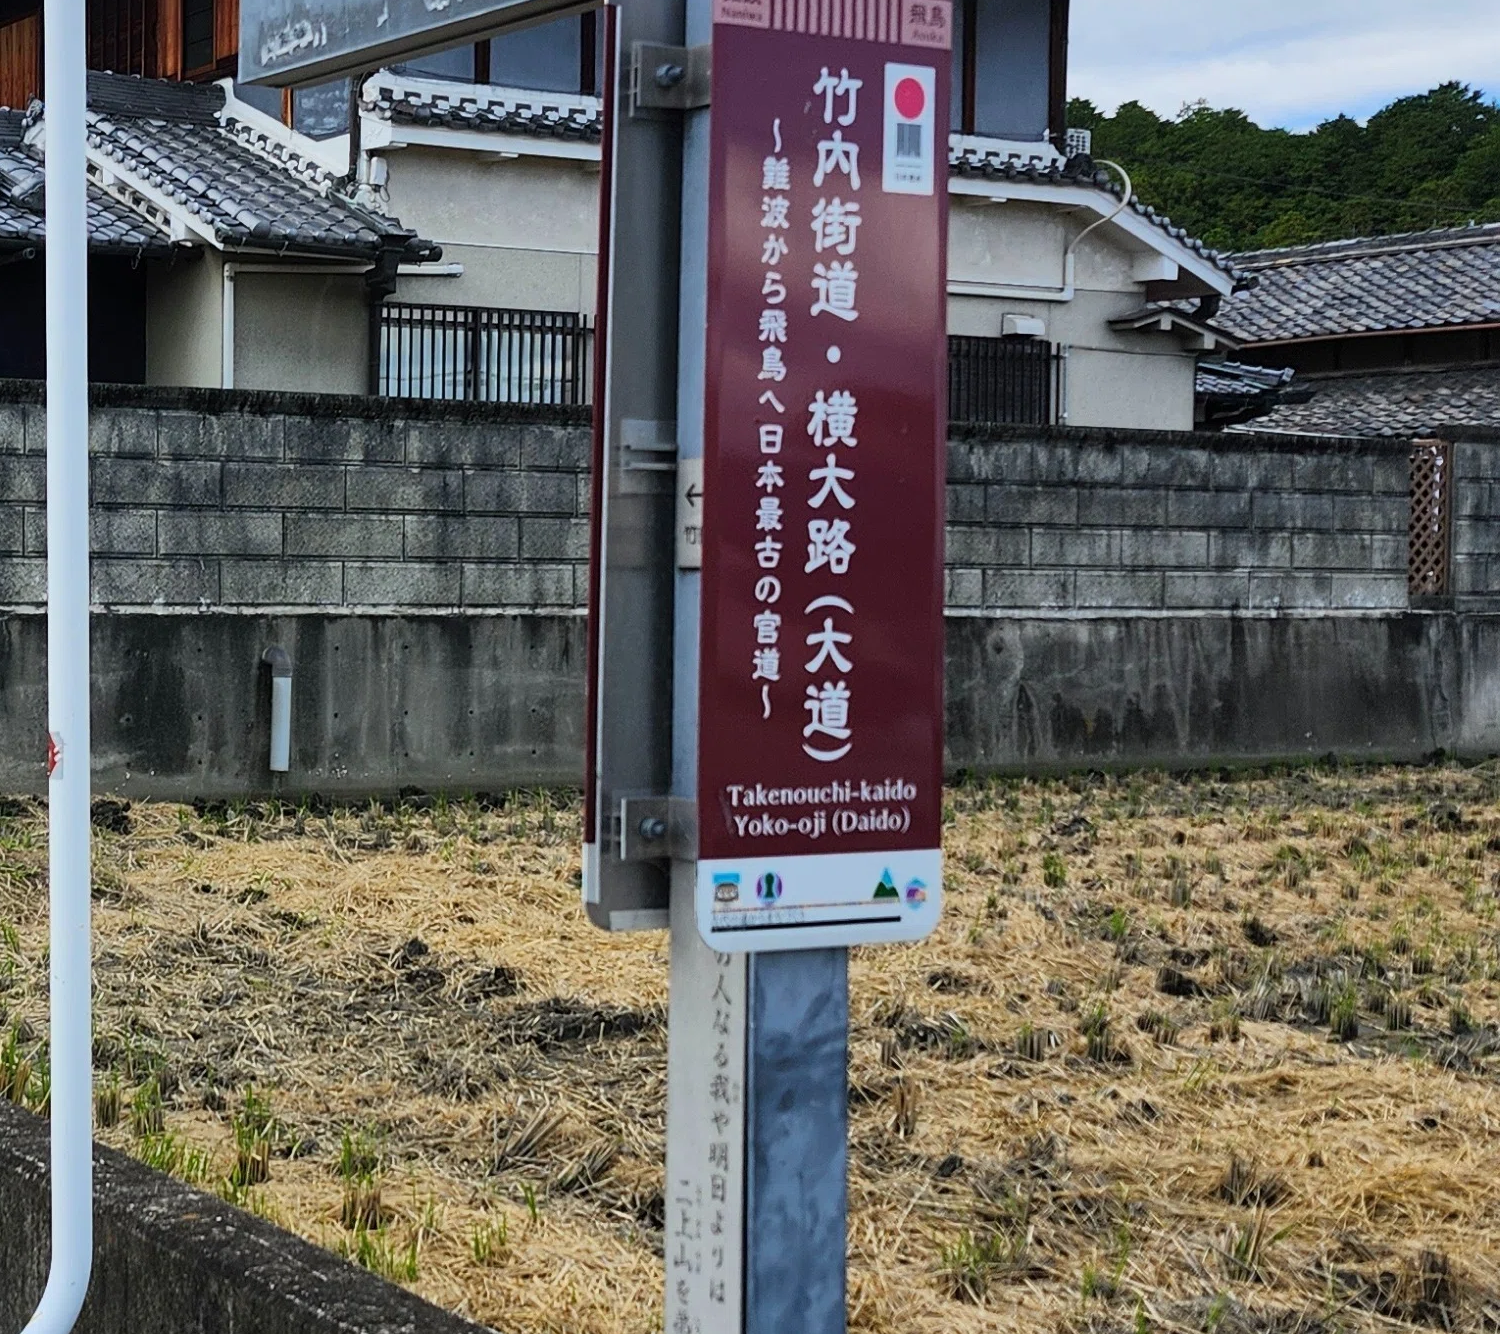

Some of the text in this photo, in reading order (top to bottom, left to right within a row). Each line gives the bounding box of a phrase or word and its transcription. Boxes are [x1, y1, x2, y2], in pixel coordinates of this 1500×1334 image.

[909, 3, 947, 30] 飛鳥
[725, 777, 918, 808] Takenouchi-kaido
[732, 805, 912, 840] Yoko-oji (Daido)
